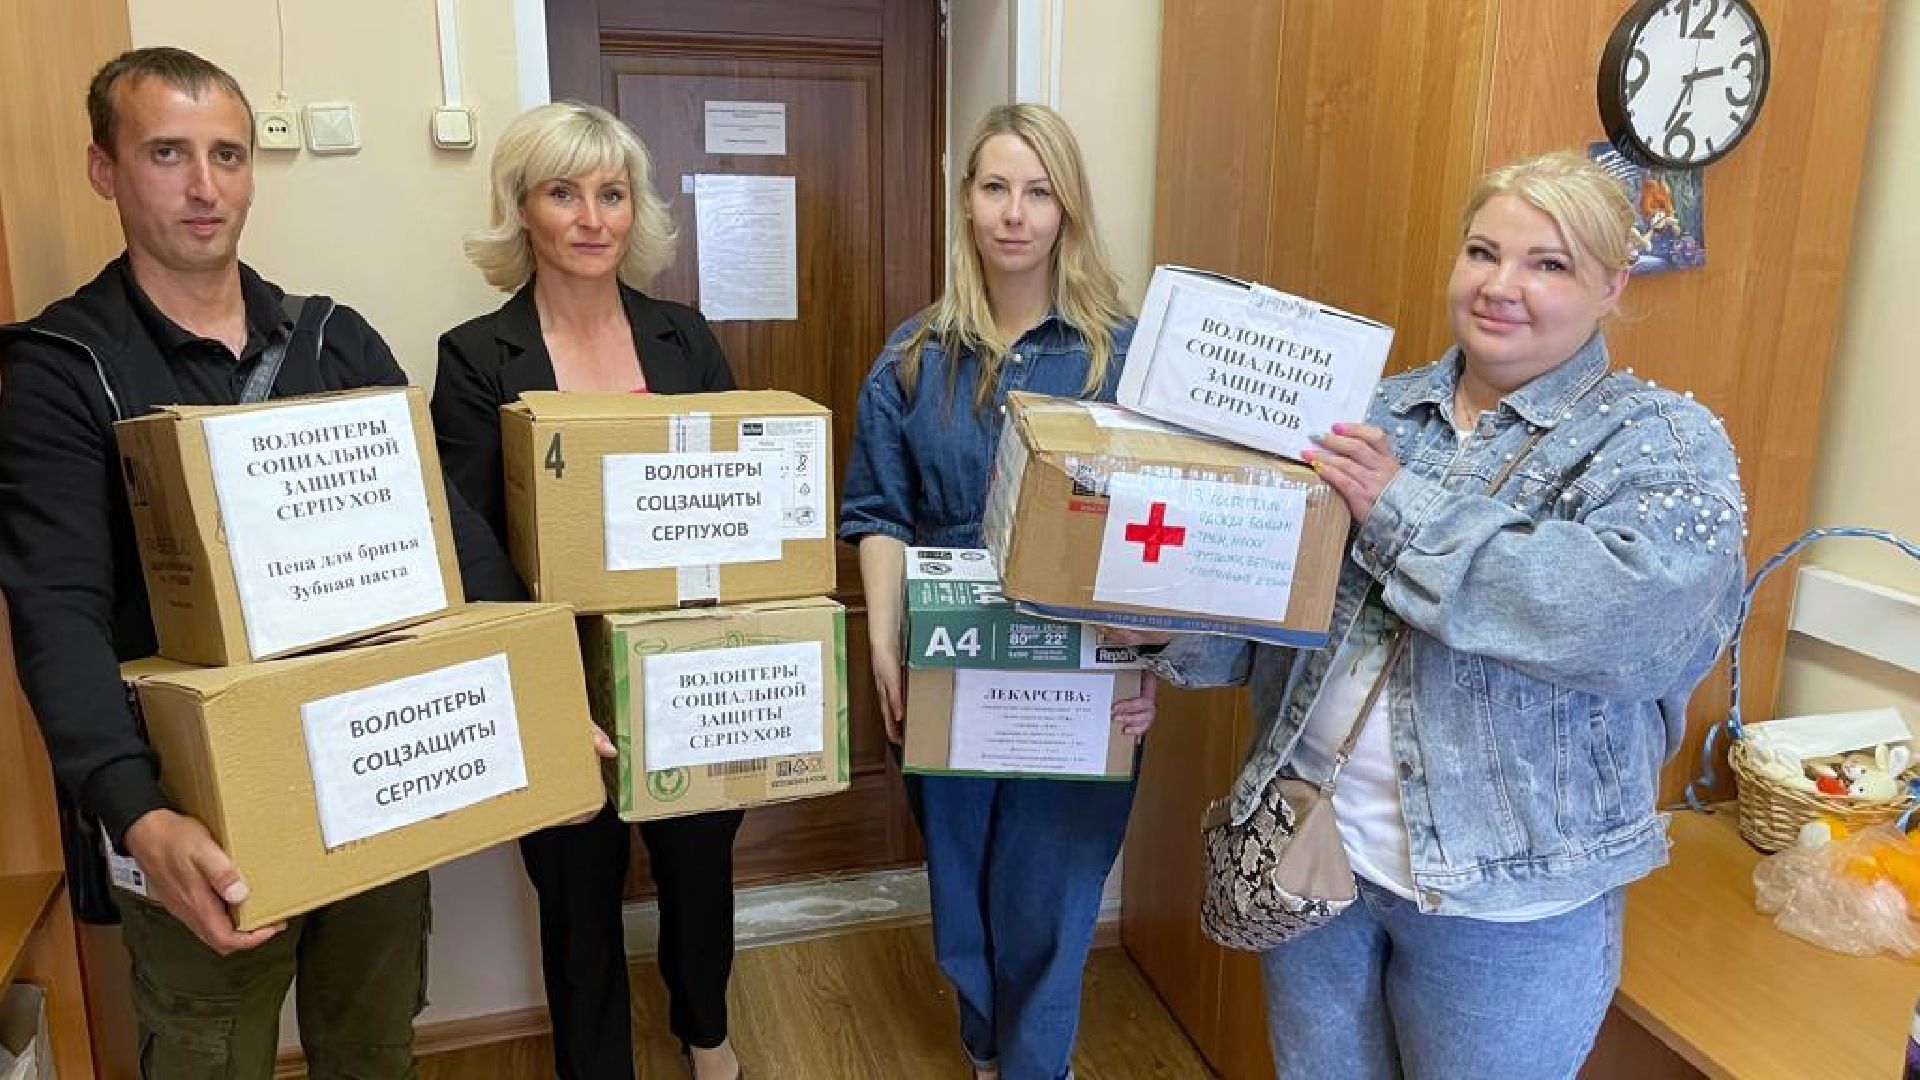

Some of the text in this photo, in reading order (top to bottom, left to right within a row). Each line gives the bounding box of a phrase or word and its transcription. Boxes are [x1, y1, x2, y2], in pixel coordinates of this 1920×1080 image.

[1674, 0, 1719, 40] 12
[1726, 52, 1756, 107] 3
[1663, 111, 1696, 162] 6
[1201, 318, 1332, 367] ВОЛОНТЕРЫ
[1185, 338, 1333, 391] СОЦИАЛЬНОЙ
[1207, 367, 1299, 405] ЗАЩИТЫ
[1190, 387, 1303, 429] СЕРПУХОВ
[251, 419, 388, 452] ВОЛОНТЕРЫ
[246, 436, 400, 478] СОЦИАЛЬНОЙ
[544, 432, 565, 479] 4
[645, 462, 762, 481] ВОЛОНТЕРЫ
[281, 466, 378, 497] ЗАЩИТЫ
[276, 487, 392, 521] СЕРПУХОВ
[636, 492, 762, 513] СОЦЗАЩИТЫ
[652, 522, 749, 541] СЕРПУХОВ
[267, 536, 420, 578] Пена для бритья
[289, 565, 409, 602] Зубная паста
[924, 626, 981, 657] A4
[679, 664, 798, 688] ВОЛОНТЕРЫ
[350, 687, 486, 738] ВОЛОНТЕРЫ
[672, 682, 807, 709] СОЦИАЛЬНОЙ
[984, 688, 1092, 703] ЛЕКАРСТВА:
[698, 706, 782, 727] ЗАЩИТЫ
[352, 720, 496, 775] СОЦЗАЩИТЫ
[690, 726, 792, 749] СЕРПУХОВ
[376, 759, 487, 806] СЕРПУХОВ
